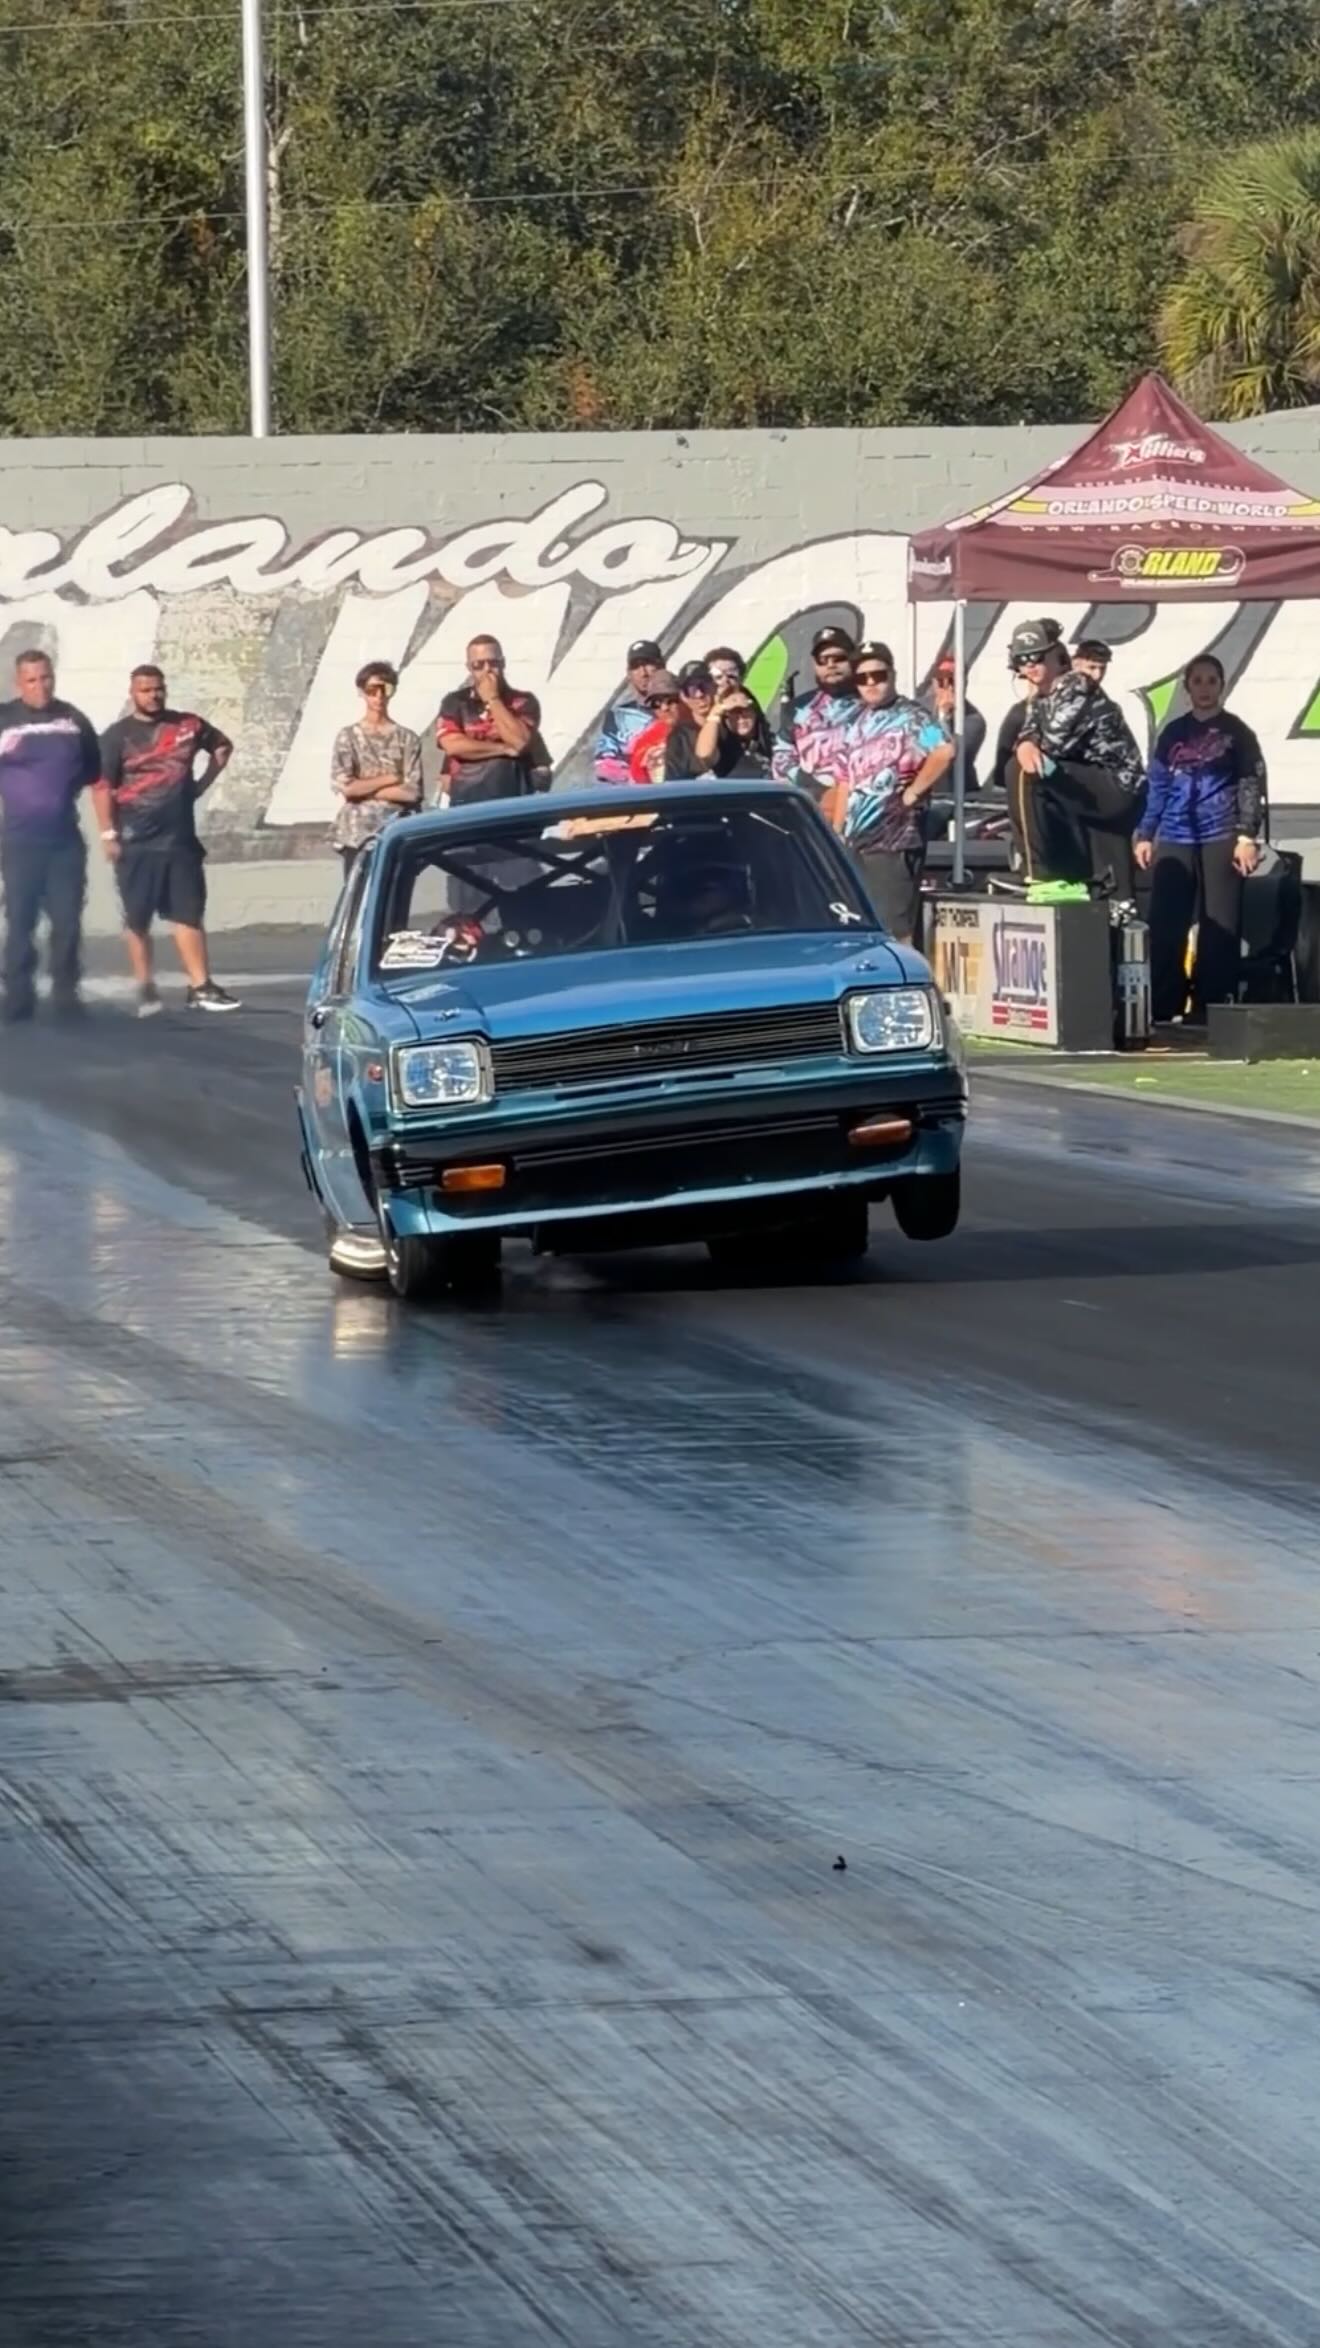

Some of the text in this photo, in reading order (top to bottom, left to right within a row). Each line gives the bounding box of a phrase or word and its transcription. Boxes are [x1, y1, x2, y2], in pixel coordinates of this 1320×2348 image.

[1047, 493, 1288, 518] ORLANDO SPEED WORLD
